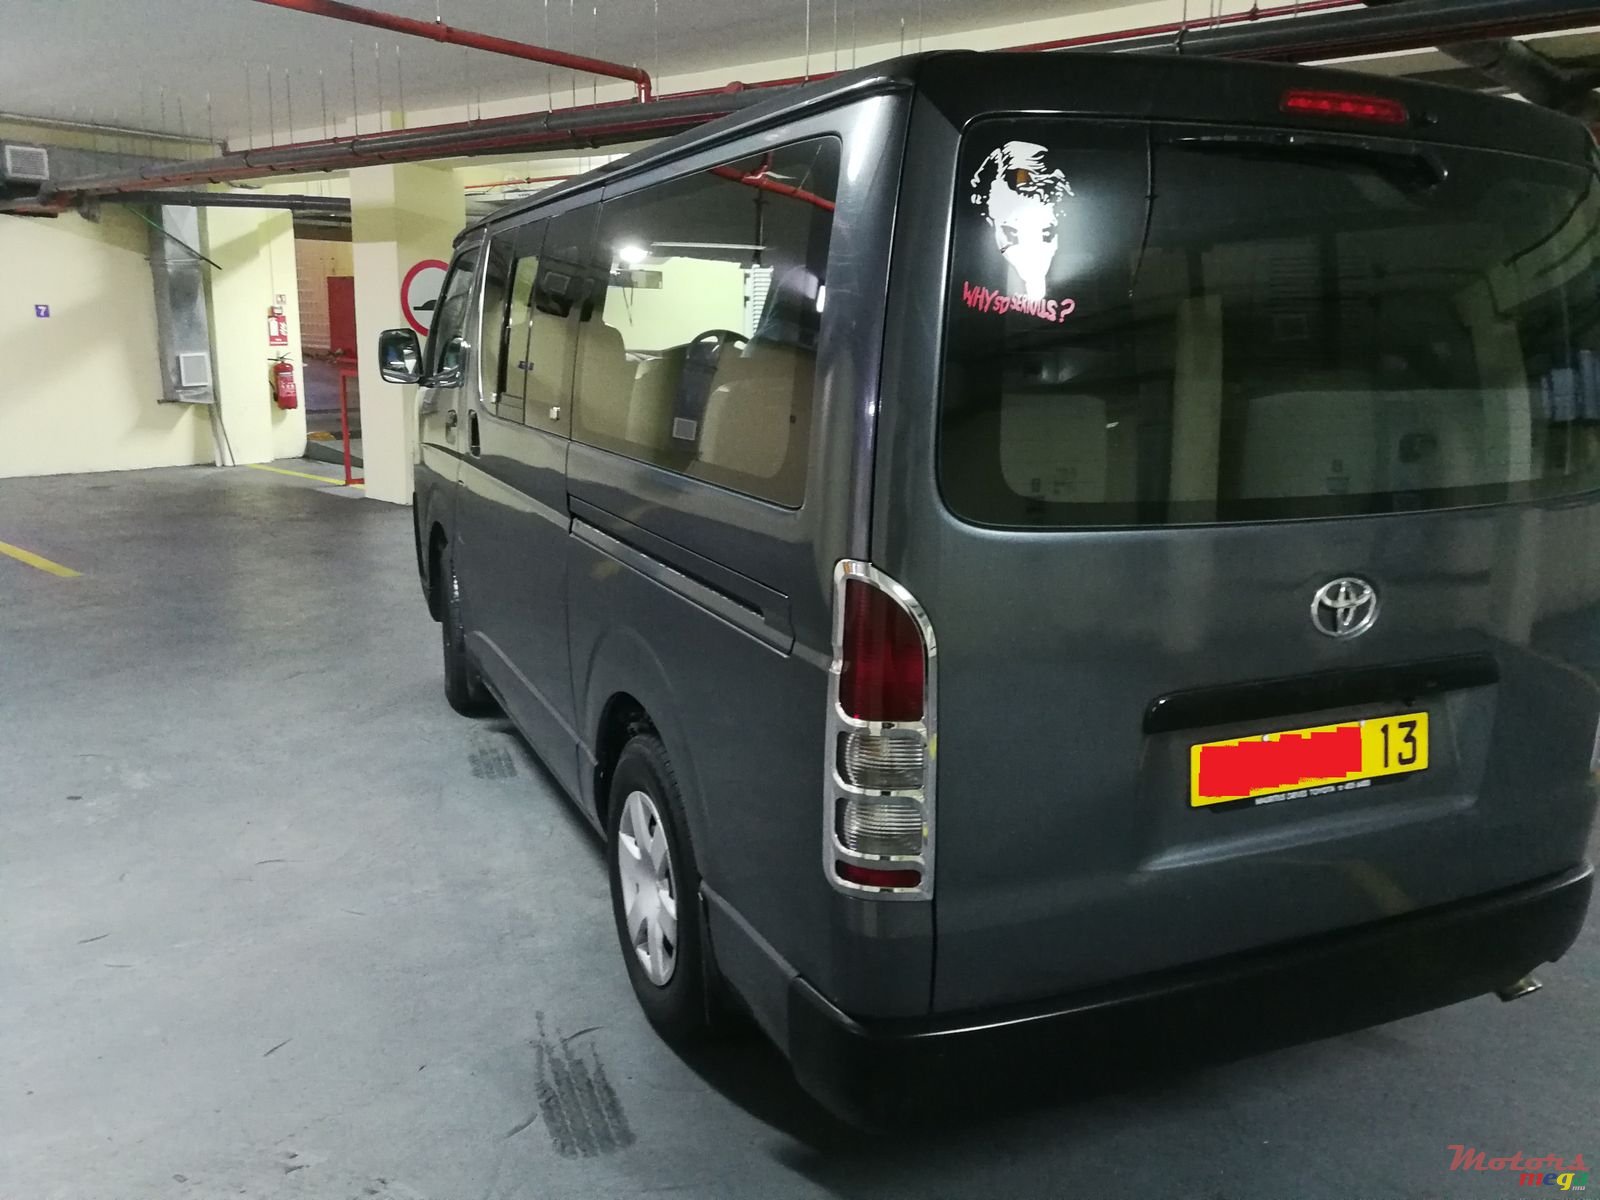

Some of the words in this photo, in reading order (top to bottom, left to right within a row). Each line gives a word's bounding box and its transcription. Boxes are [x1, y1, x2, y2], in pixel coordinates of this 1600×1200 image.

[37, 305, 47, 317] 7
[963, 281, 999, 313] WHY
[992, 295, 1010, 315] SO
[1380, 720, 1418, 769] 13
